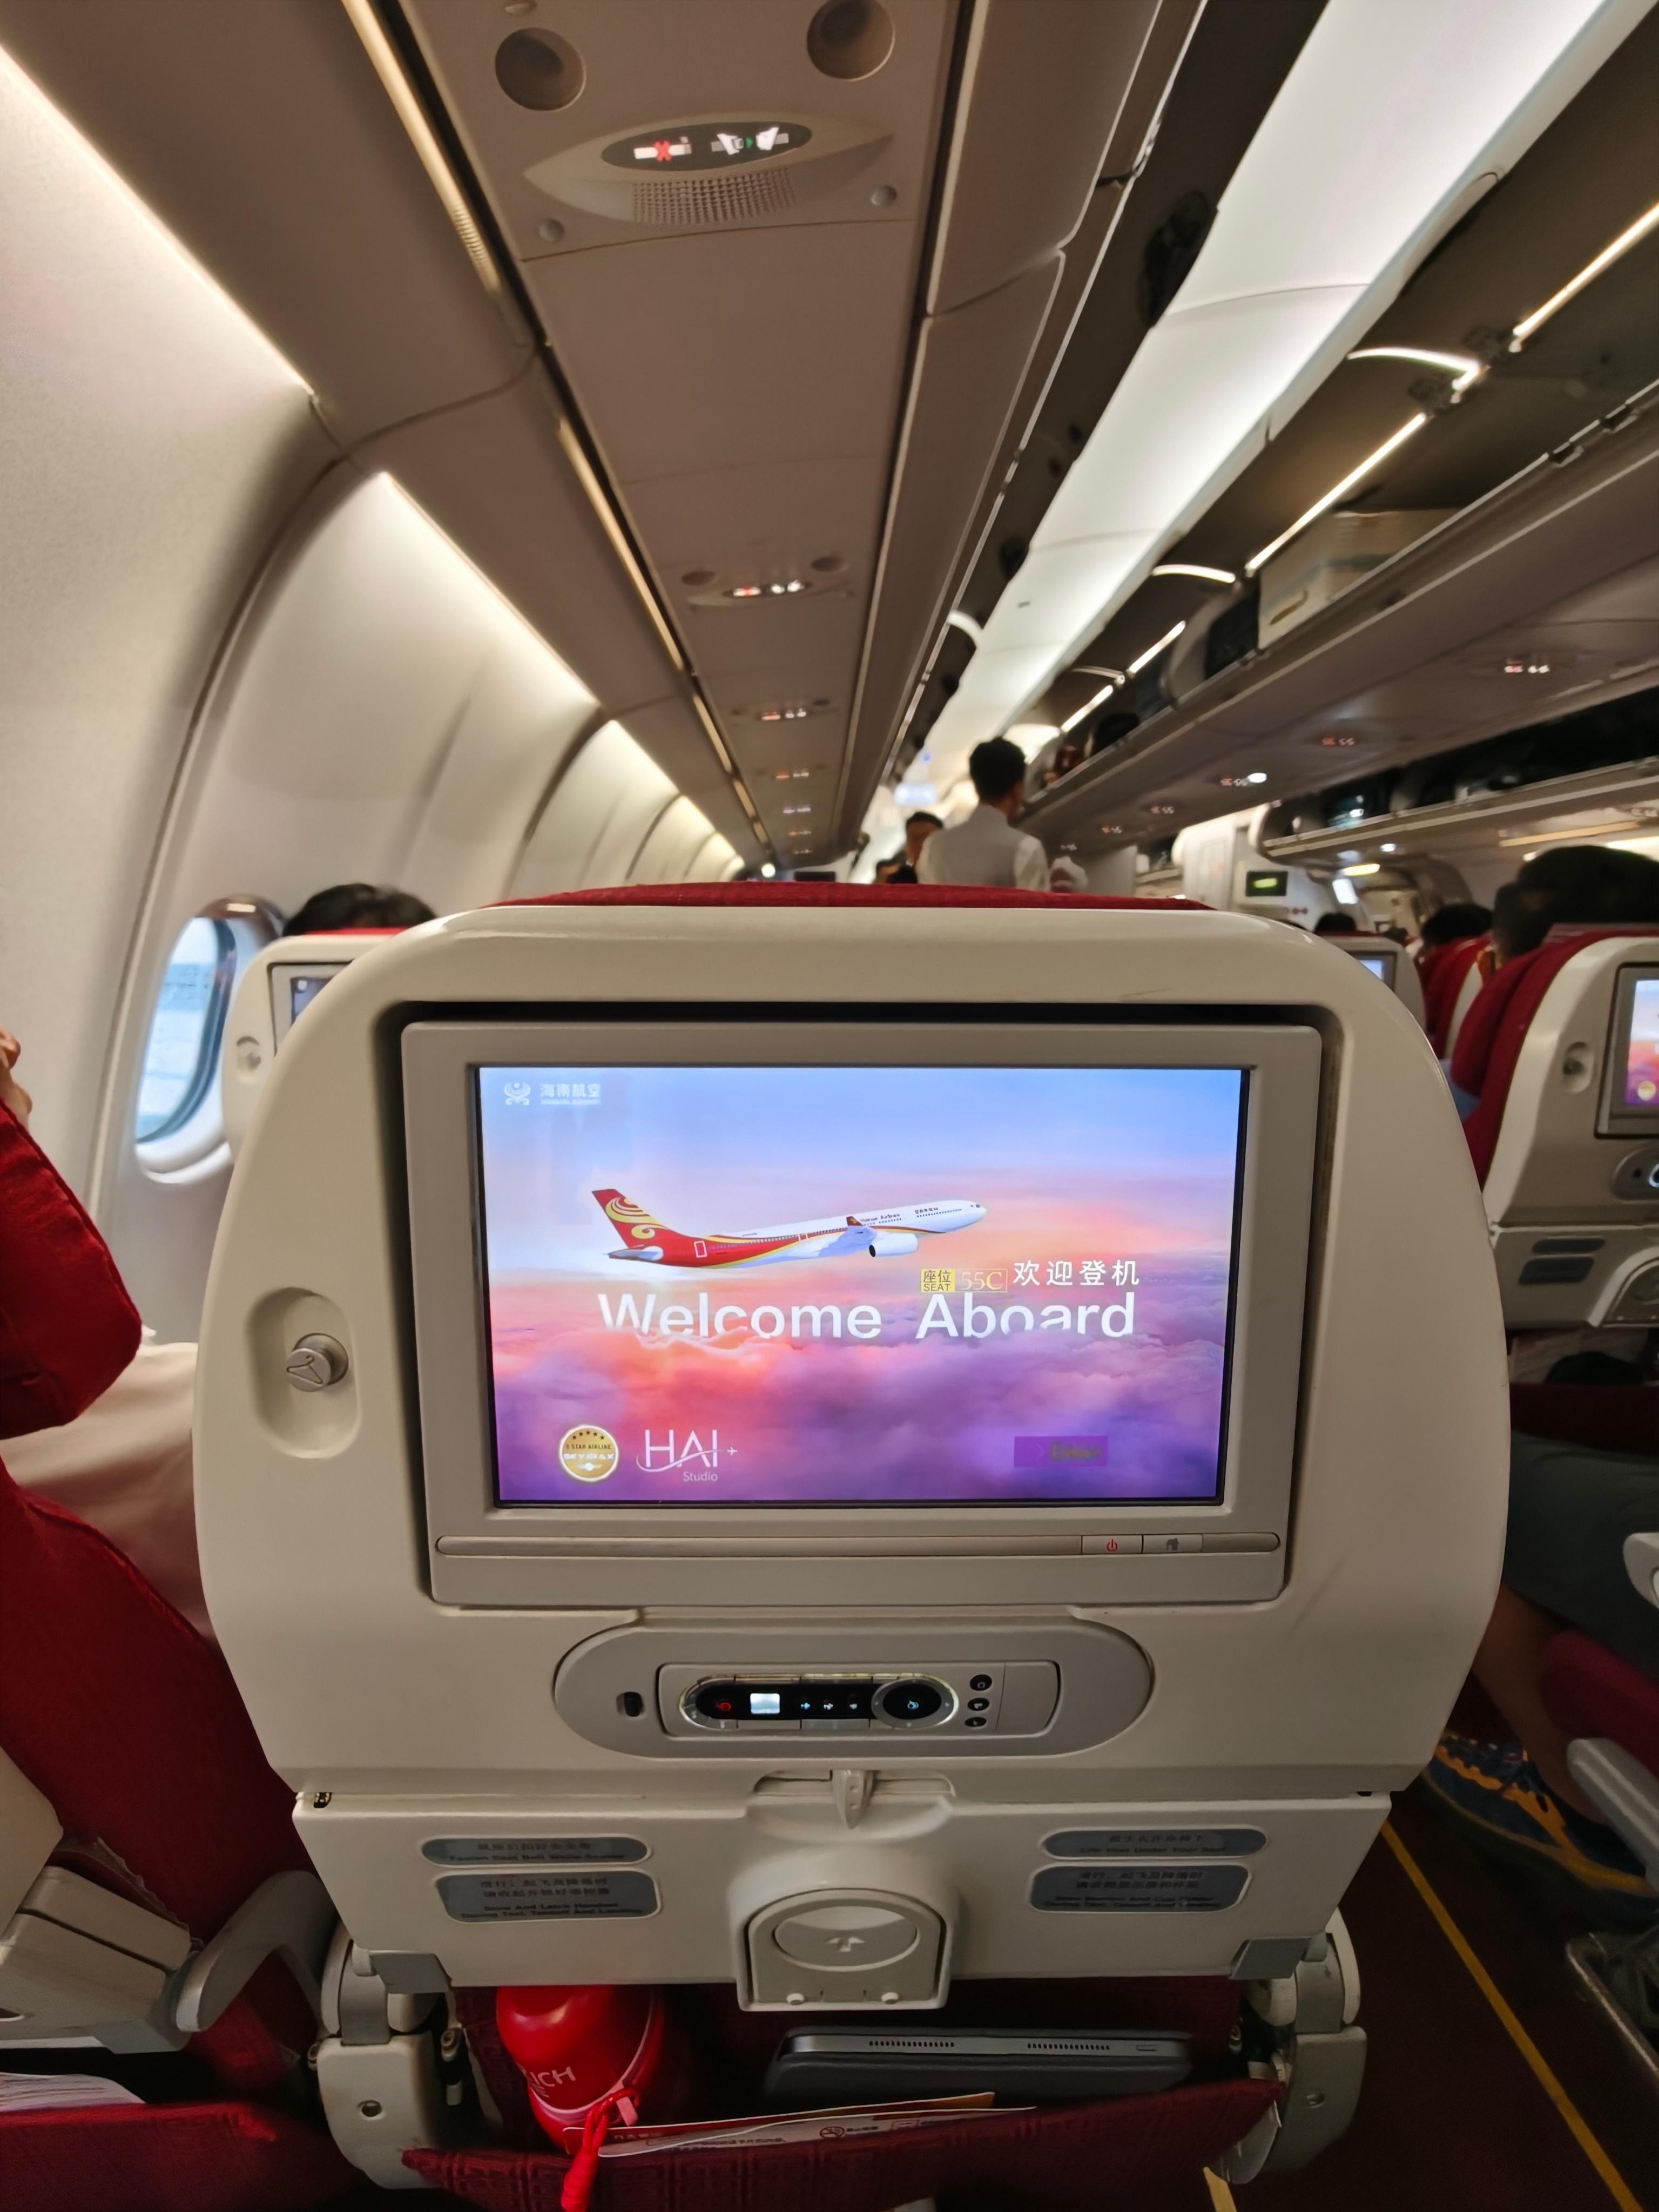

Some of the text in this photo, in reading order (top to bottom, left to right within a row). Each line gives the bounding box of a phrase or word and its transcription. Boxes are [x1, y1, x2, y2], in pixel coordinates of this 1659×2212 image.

[923, 1270, 951, 1283] 座位
[960, 1271, 1003, 1290] 55C
[1013, 1260, 1139, 1286] 欢迎登机
[923, 1283, 950, 1292] SEAT
[597, 1292, 1134, 1339] Welcome Aboard
[683, 1471, 718, 1482] Studio
